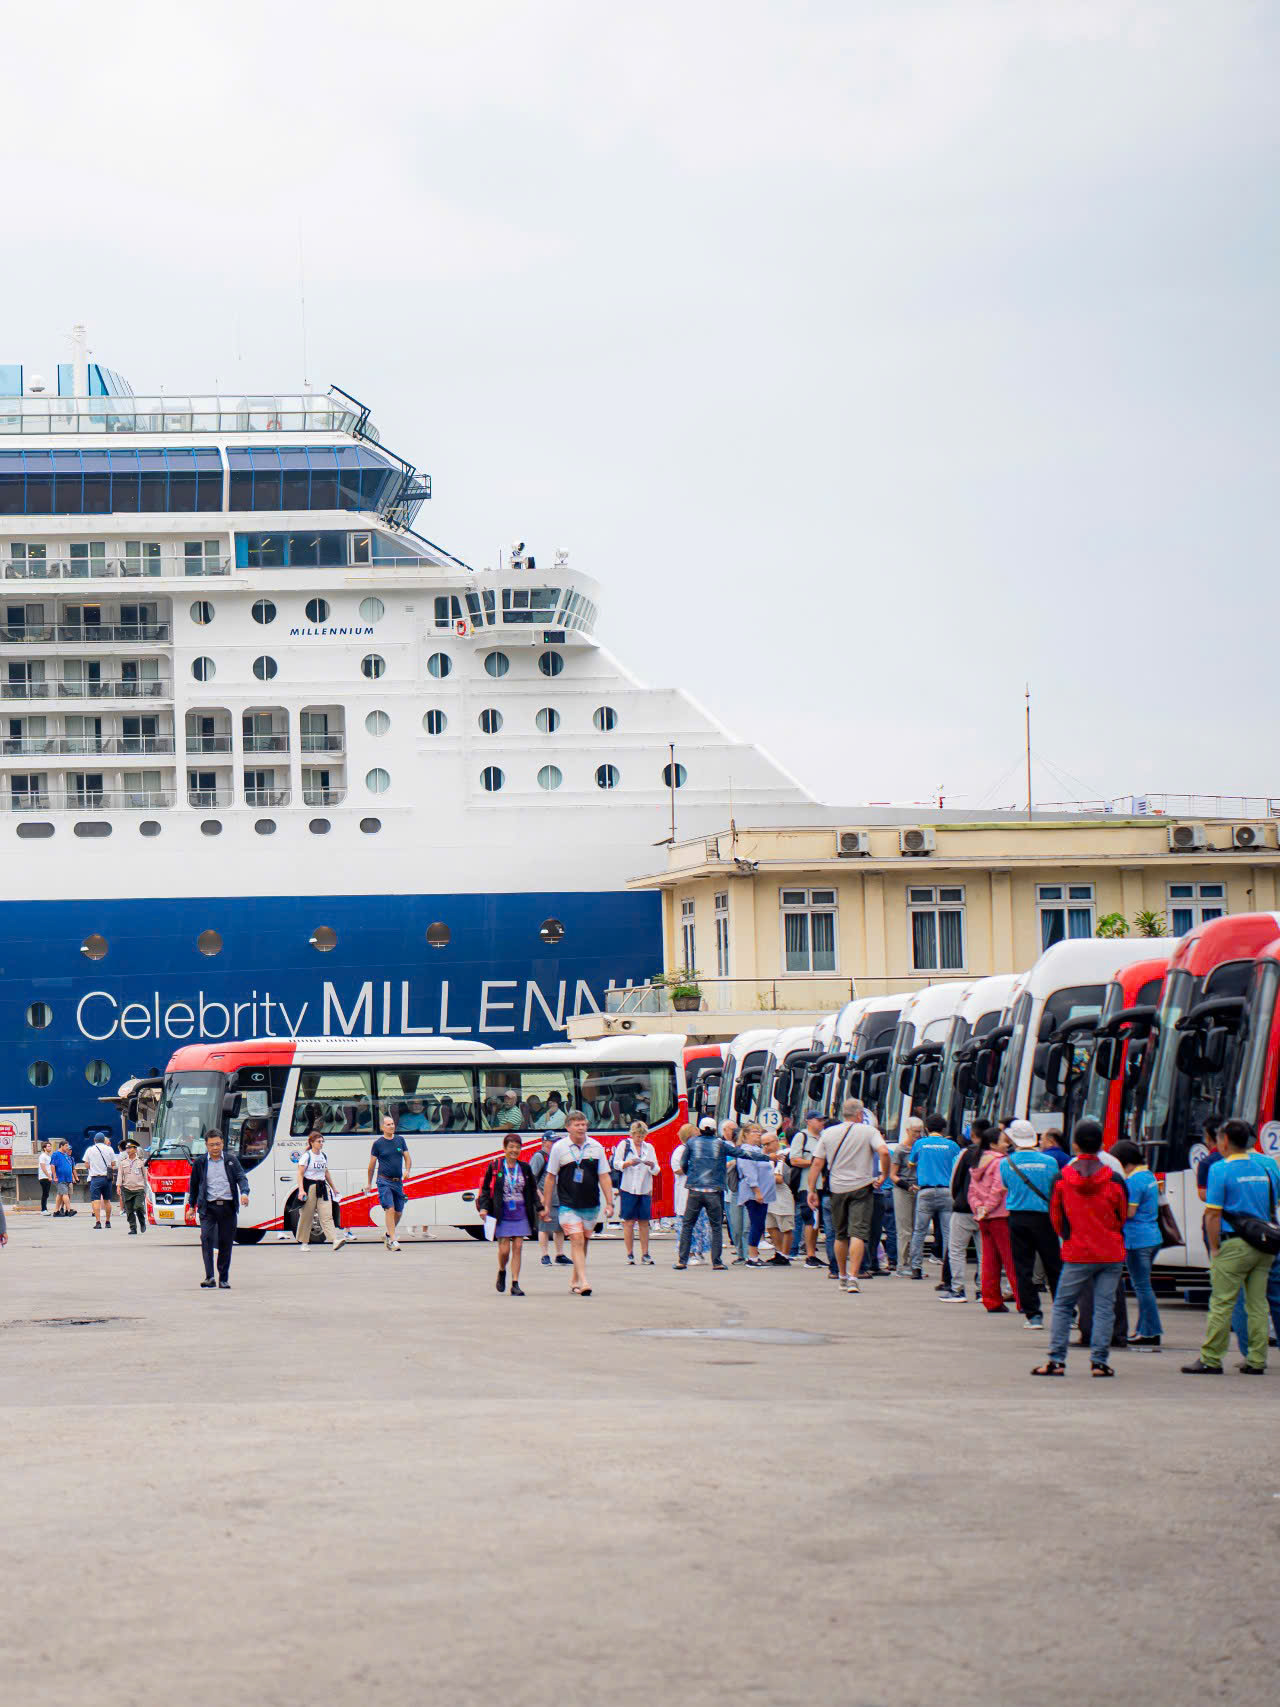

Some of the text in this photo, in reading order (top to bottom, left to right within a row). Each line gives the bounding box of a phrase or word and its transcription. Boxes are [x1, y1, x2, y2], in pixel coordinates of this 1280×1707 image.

[289, 627, 375, 636] MILLENNIUM
[76, 979, 651, 1038] Celebrity MILLENN
[763, 1112, 778, 1125] 13
